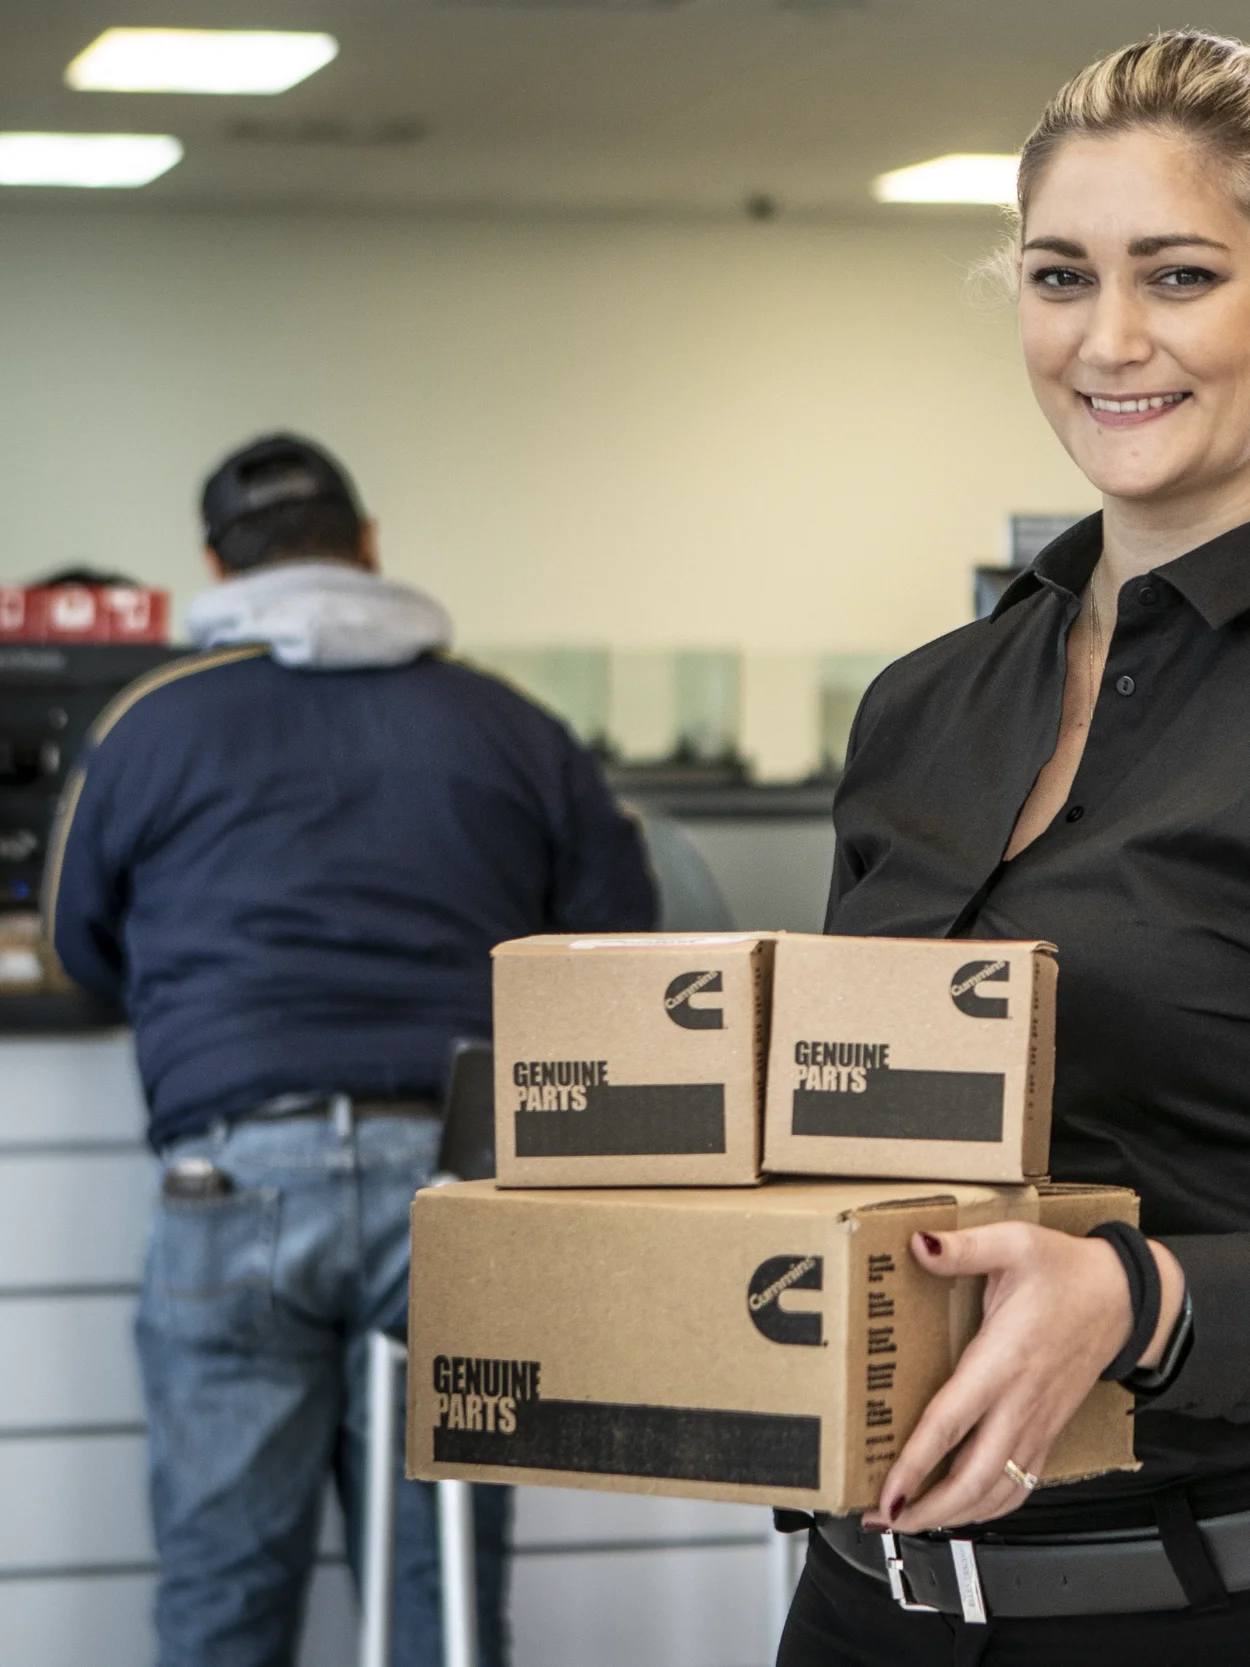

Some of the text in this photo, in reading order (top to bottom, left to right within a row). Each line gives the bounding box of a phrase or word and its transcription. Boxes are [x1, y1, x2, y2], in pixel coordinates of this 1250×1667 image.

[664, 970, 718, 1009] Cummins
[950, 960, 1006, 997] Cummins
[795, 1040, 889, 1068] GENUINE
[513, 1060, 608, 1088] GENUINE
[795, 1065, 867, 1094] PARTS
[516, 1085, 588, 1112] PARTS
[749, 1256, 816, 1311] Cummins
[433, 1354, 541, 1401] GENUINE
[435, 1392, 517, 1435] PARTS
